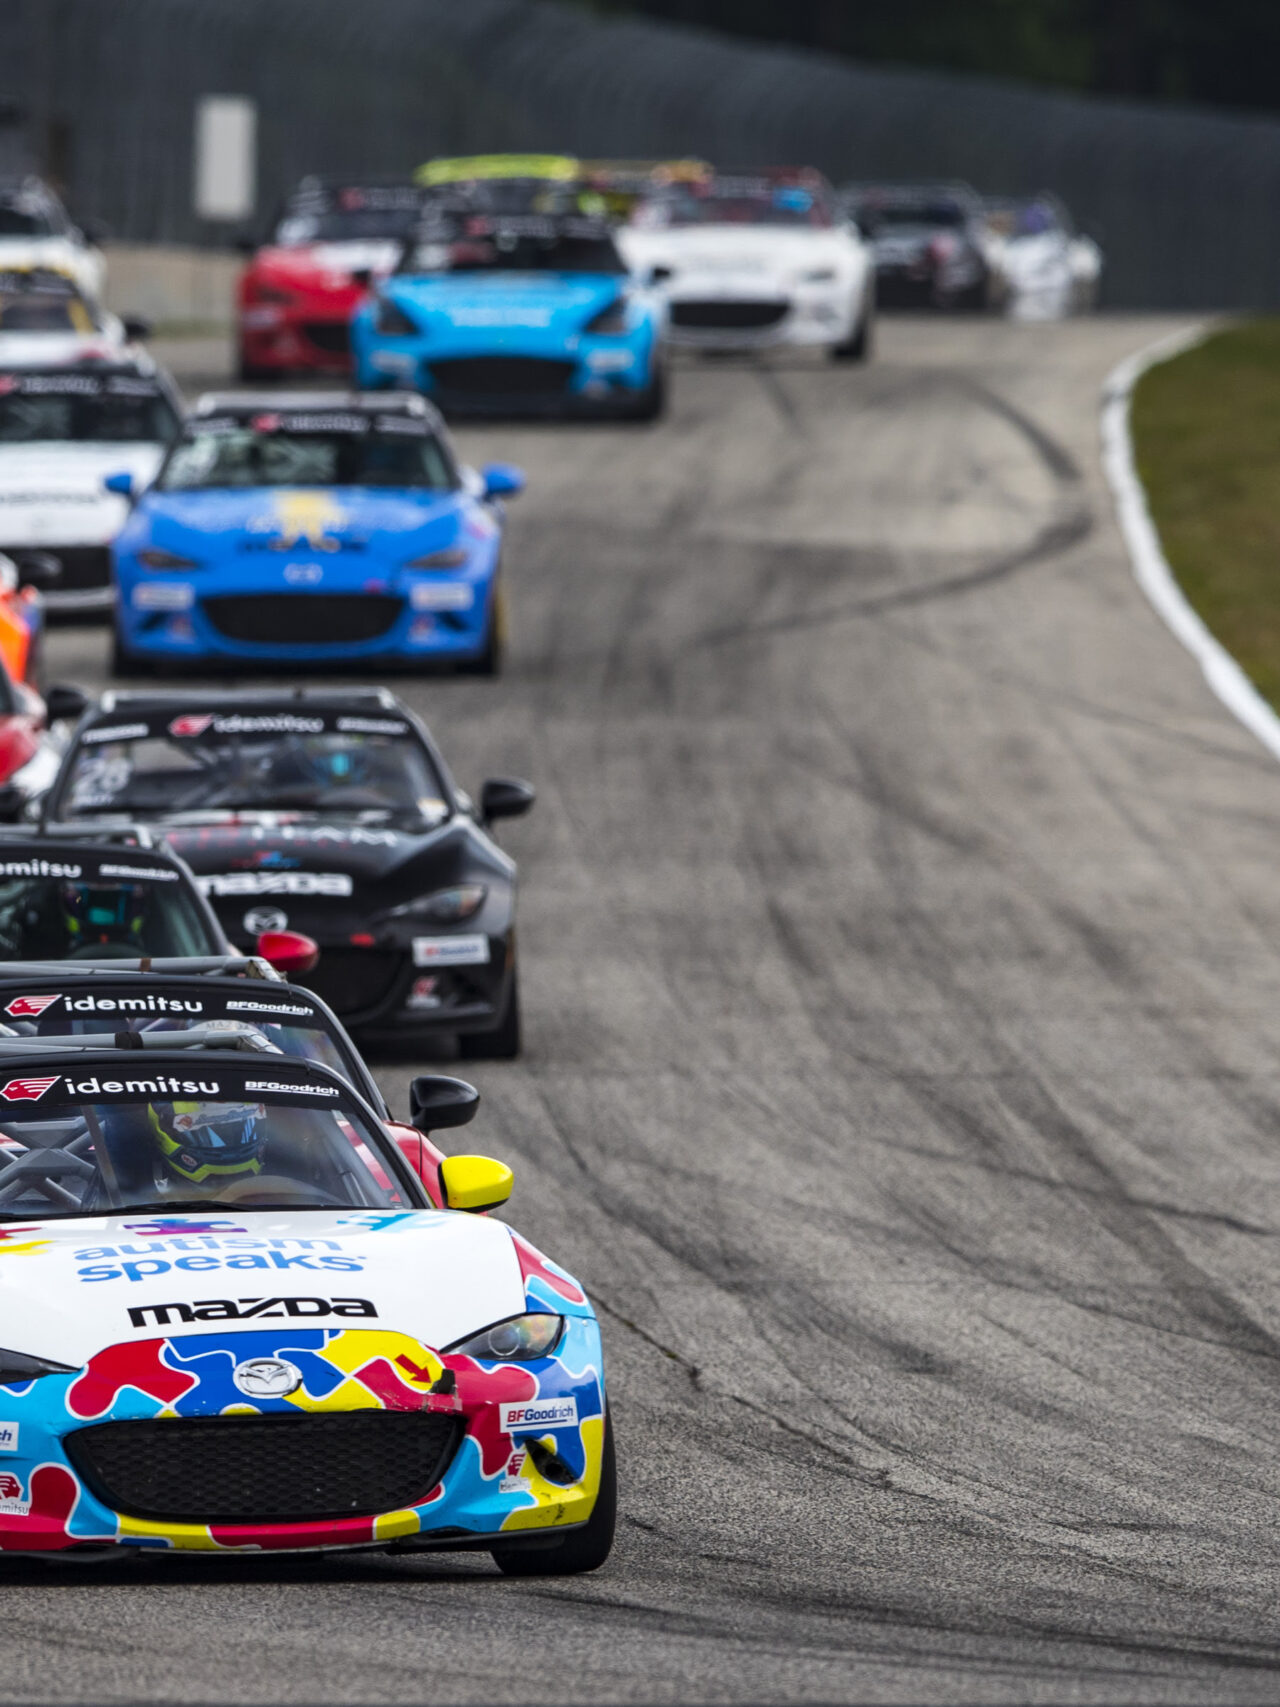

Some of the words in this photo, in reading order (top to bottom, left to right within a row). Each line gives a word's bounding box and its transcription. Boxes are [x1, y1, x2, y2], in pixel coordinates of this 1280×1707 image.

[64, 995, 203, 1013] idemitsu
[226, 1000, 314, 1016] BFGoodrich
[65, 1076, 220, 1095] idemitsu
[245, 1080, 339, 1097] BFGoodrich
[72, 1236, 344, 1261] autism
[76, 1250, 366, 1282] speaks
[126, 1297, 379, 1328] mazda
[507, 1405, 574, 1423] BFGoodrich
